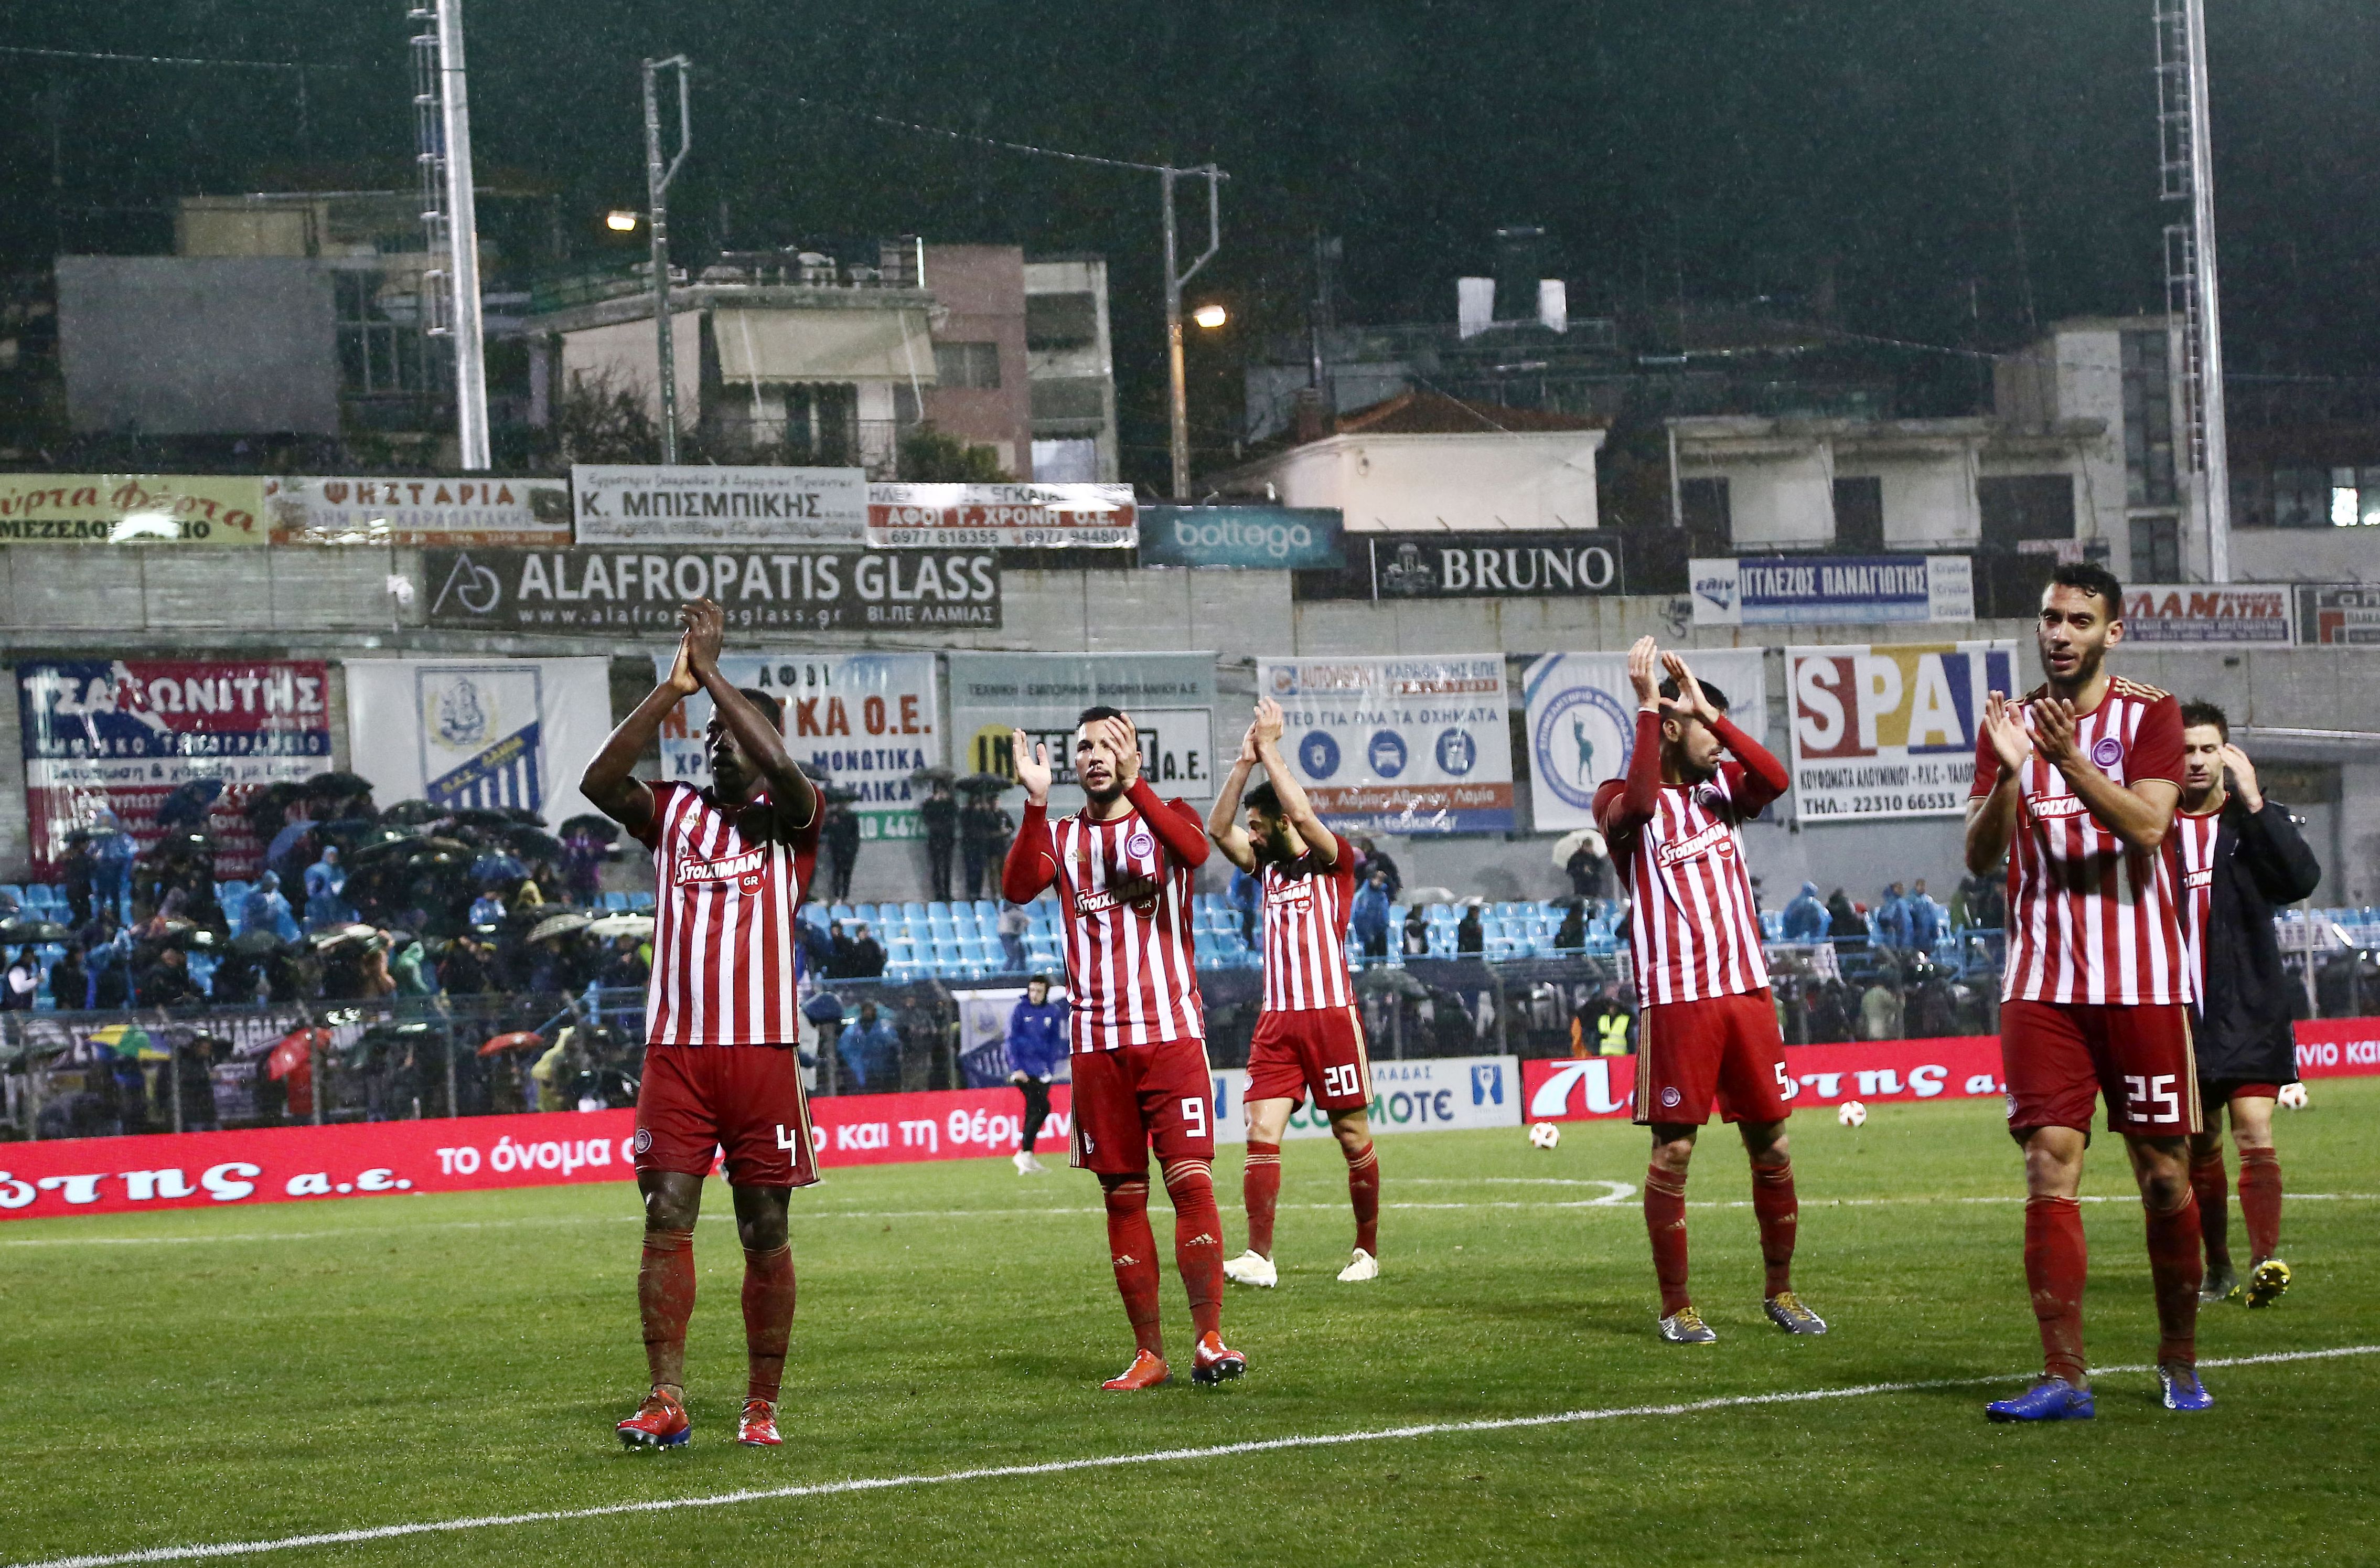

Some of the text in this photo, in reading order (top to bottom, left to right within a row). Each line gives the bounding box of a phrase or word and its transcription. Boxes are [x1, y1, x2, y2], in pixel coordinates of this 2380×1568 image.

[581, 491, 822, 517] Κ. ΜΠΙΣΜΠΙΚΗΣ
[518, 553, 995, 601] ALAFROPATIS GLASS
[1440, 547, 1615, 590] BRUNO
[518, 605, 841, 626] www.alafropsglass.gr
[921, 605, 993, 622] ΛΑΜΙΑΣ
[863, 694, 932, 735] Ο.Ε.
[1321, 710, 1347, 726] ΓΙΑ
[1853, 794, 1903, 813] 22310
[1907, 791, 1956, 809] 66533
[1718, 840, 1731, 851] GR
[743, 876, 759, 886] GR
[1324, 1063, 1360, 1097] 20
[1774, 1061, 1793, 1102] 5
[2125, 1074, 2180, 1124] 25
[1181, 1097, 1206, 1137] 9
[776, 1124, 796, 1167] 4
[838, 1122, 890, 1150] και
[898, 1119, 938, 1153] τη
[436, 1147, 480, 1175] το
[490, 1135, 612, 1176] όνομα
